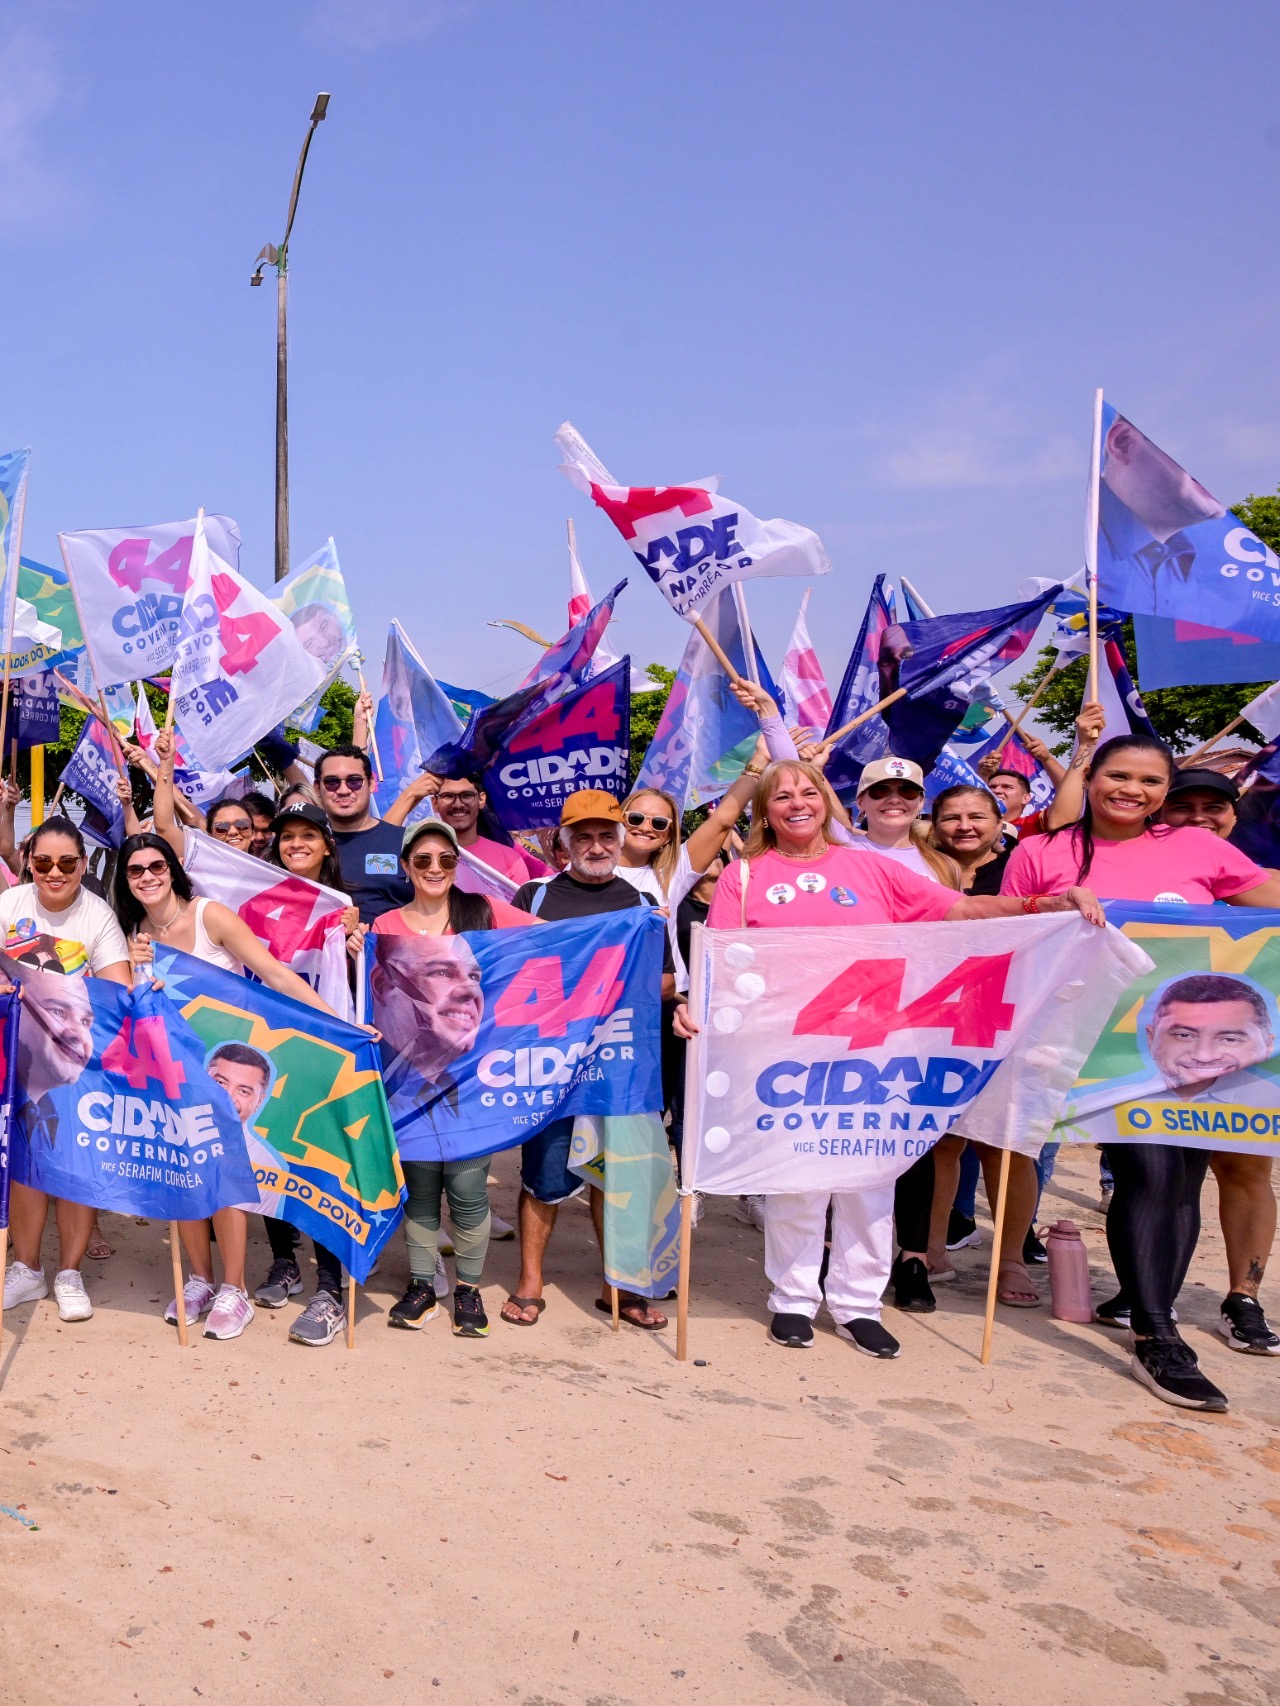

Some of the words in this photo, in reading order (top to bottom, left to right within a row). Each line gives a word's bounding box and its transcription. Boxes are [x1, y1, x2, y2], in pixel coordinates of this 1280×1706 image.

[1252, 590, 1271, 602] VICE
[494, 943, 626, 1038] 44
[792, 951, 1015, 1051] 44
[101, 1015, 187, 1099] 44
[77, 1091, 220, 1148] CIDADE
[1127, 1107, 1152, 1130] O
[76, 1132, 225, 1168] GOVERNADOR
[793, 1141, 815, 1153] VICE
[818, 1138, 896, 1156] SERAFIM
[101, 1161, 116, 1172] VICE
[118, 1161, 162, 1183] SERAFIM
[165, 1169, 203, 1189] CORRÊA
[283, 1176, 313, 1200] DO
[318, 1198, 362, 1237] POVO
